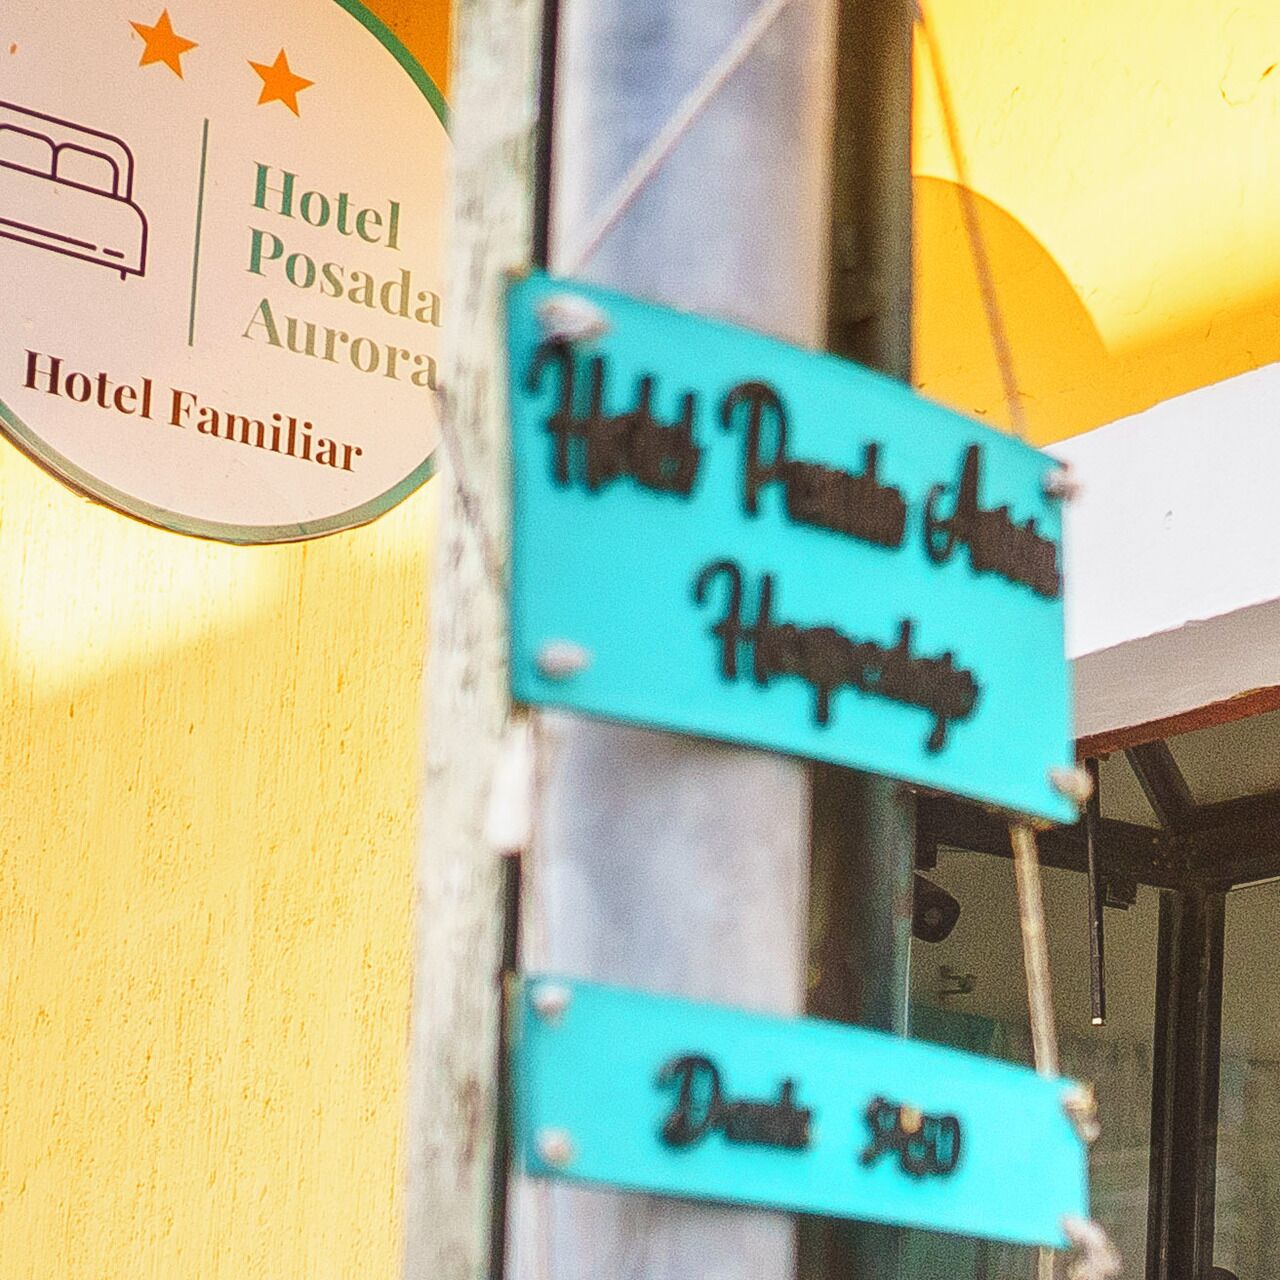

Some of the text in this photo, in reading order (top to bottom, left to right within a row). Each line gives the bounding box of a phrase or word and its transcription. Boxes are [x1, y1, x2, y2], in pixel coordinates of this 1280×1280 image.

[253, 161, 402, 251] Hotel
[246, 226, 443, 328] Posada
[242, 298, 440, 392] Aurora
[22, 348, 364, 474] Hotel Familiar
